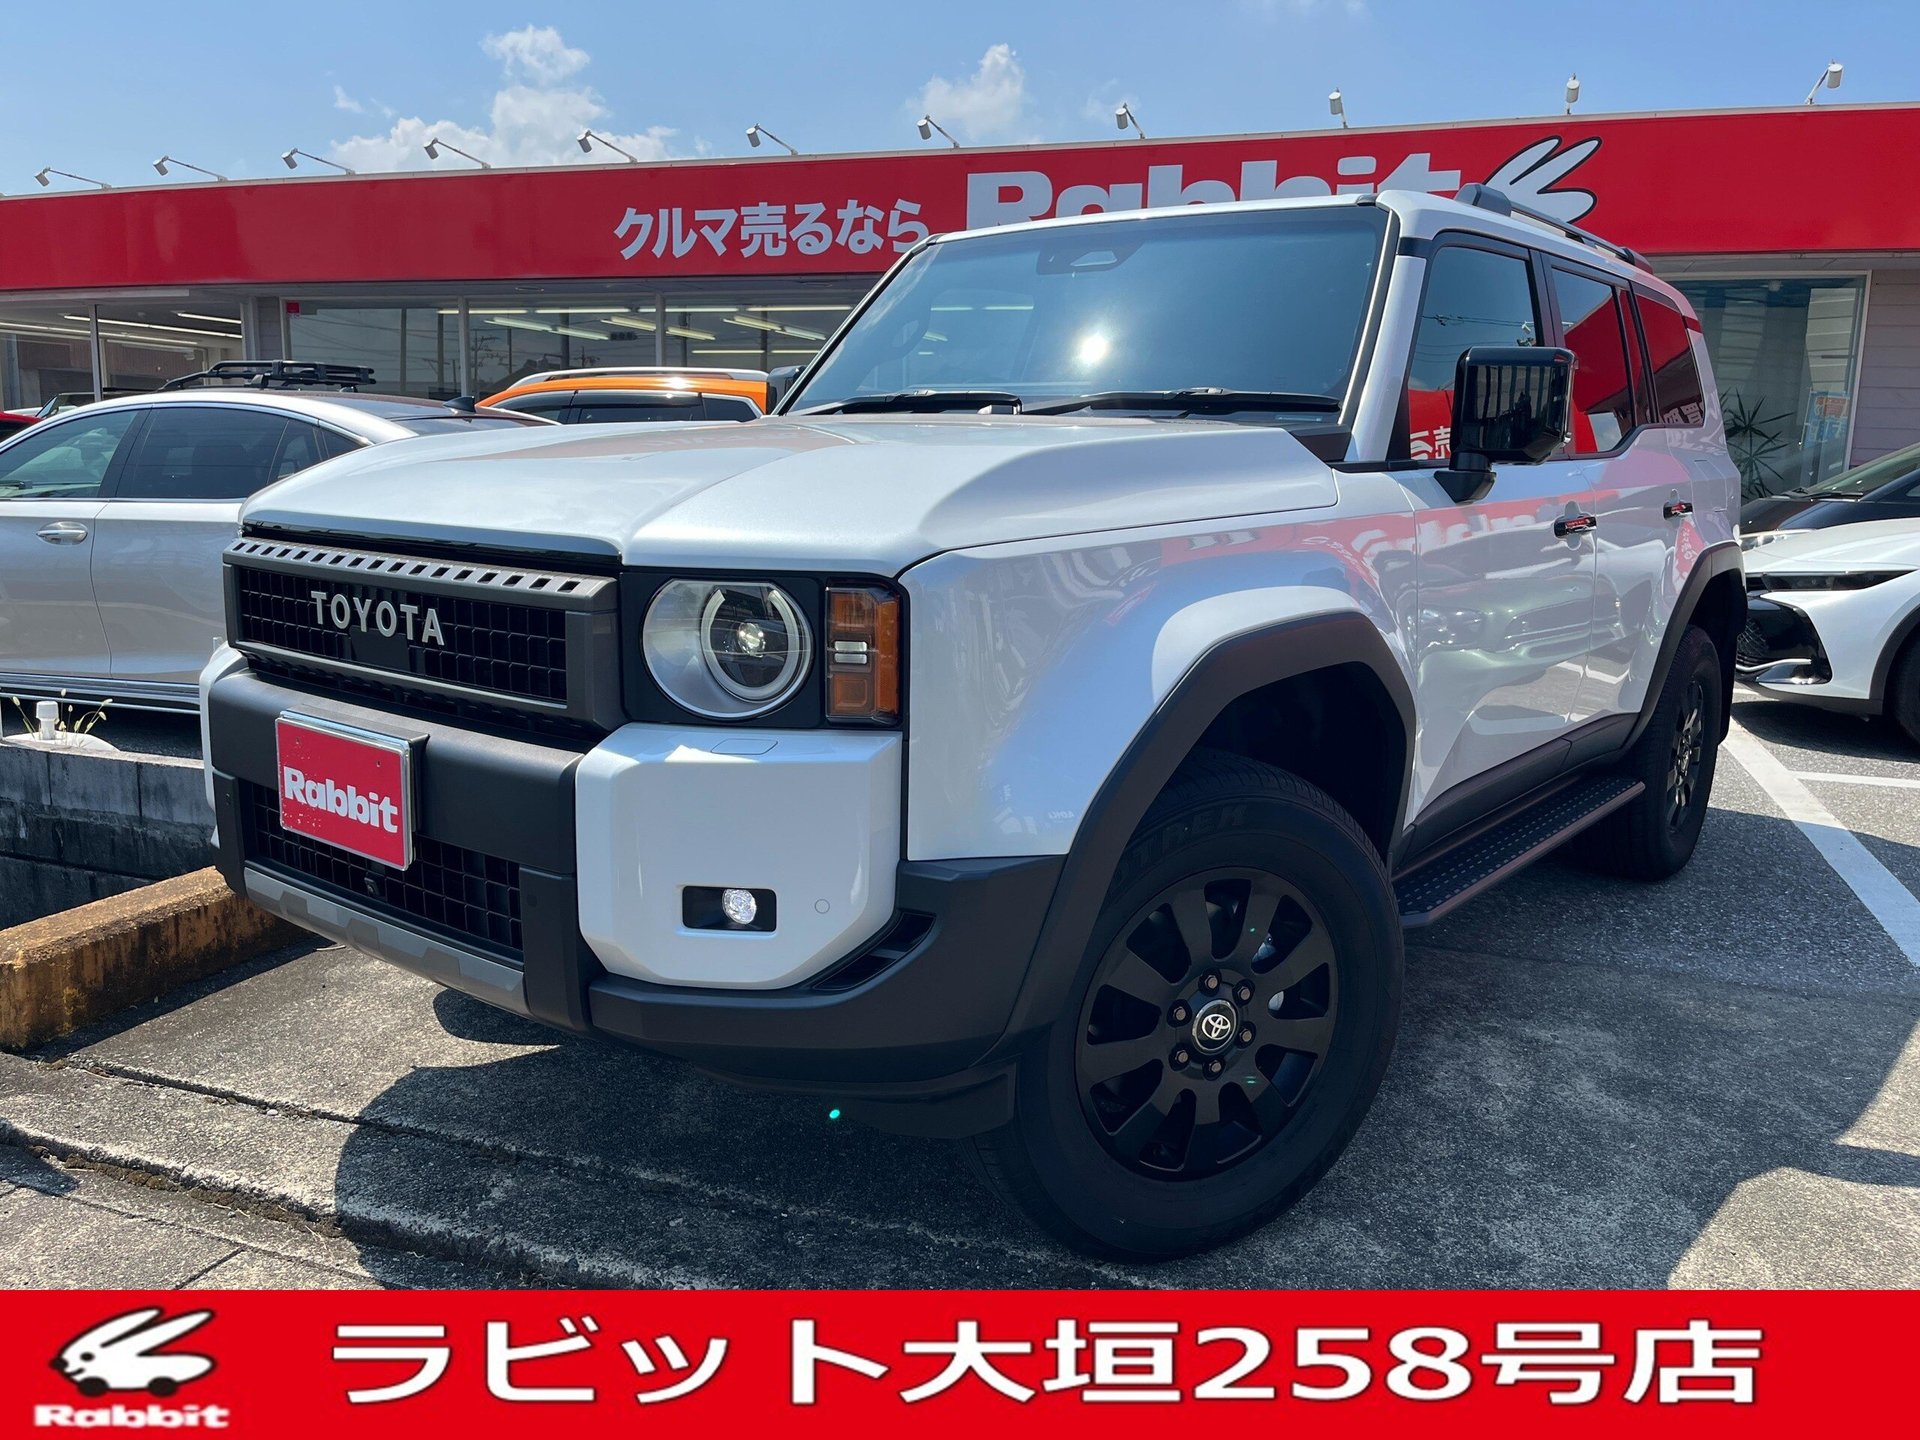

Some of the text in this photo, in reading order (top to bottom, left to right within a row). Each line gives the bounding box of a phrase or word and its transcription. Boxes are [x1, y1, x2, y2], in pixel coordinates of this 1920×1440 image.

[614, 198, 930, 260] クルマ売るなら
[310, 590, 445, 646] TOYOTA
[283, 766, 398, 833] Rabbit
